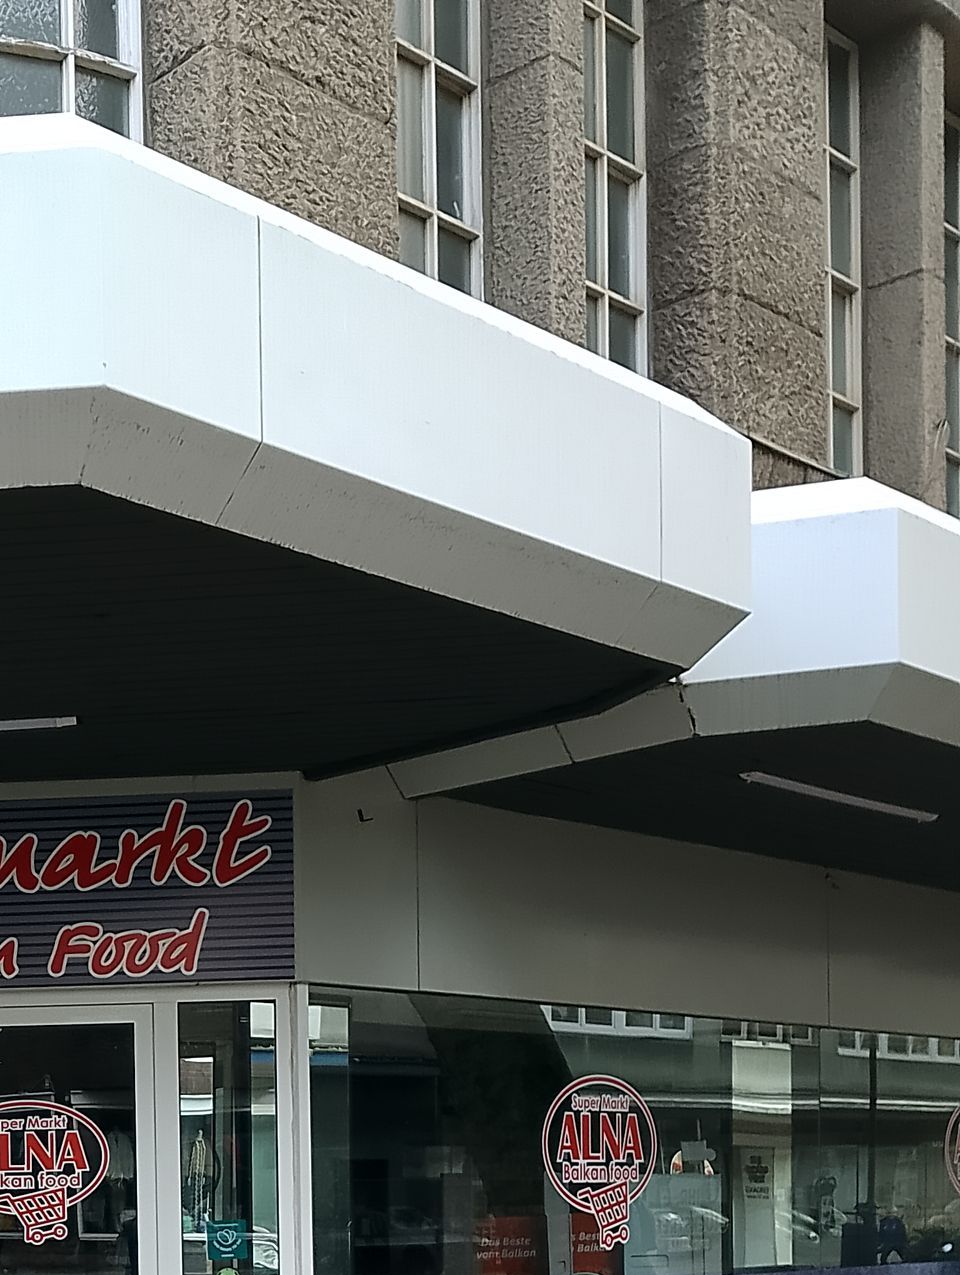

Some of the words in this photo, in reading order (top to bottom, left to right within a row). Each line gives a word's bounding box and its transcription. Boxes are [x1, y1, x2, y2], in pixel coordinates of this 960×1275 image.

[47, 907, 209, 979] Food
[571, 1093, 601, 1112] Super
[25, 1114, 68, 1130] Markt
[556, 1111, 644, 1163] ALNA
[37, 1171, 82, 1189] food
[562, 1161, 607, 1183] Balkan
[608, 1162, 640, 1182] food
[578, 1232, 600, 1241] Best
[501, 1249, 537, 1259] Balkan
